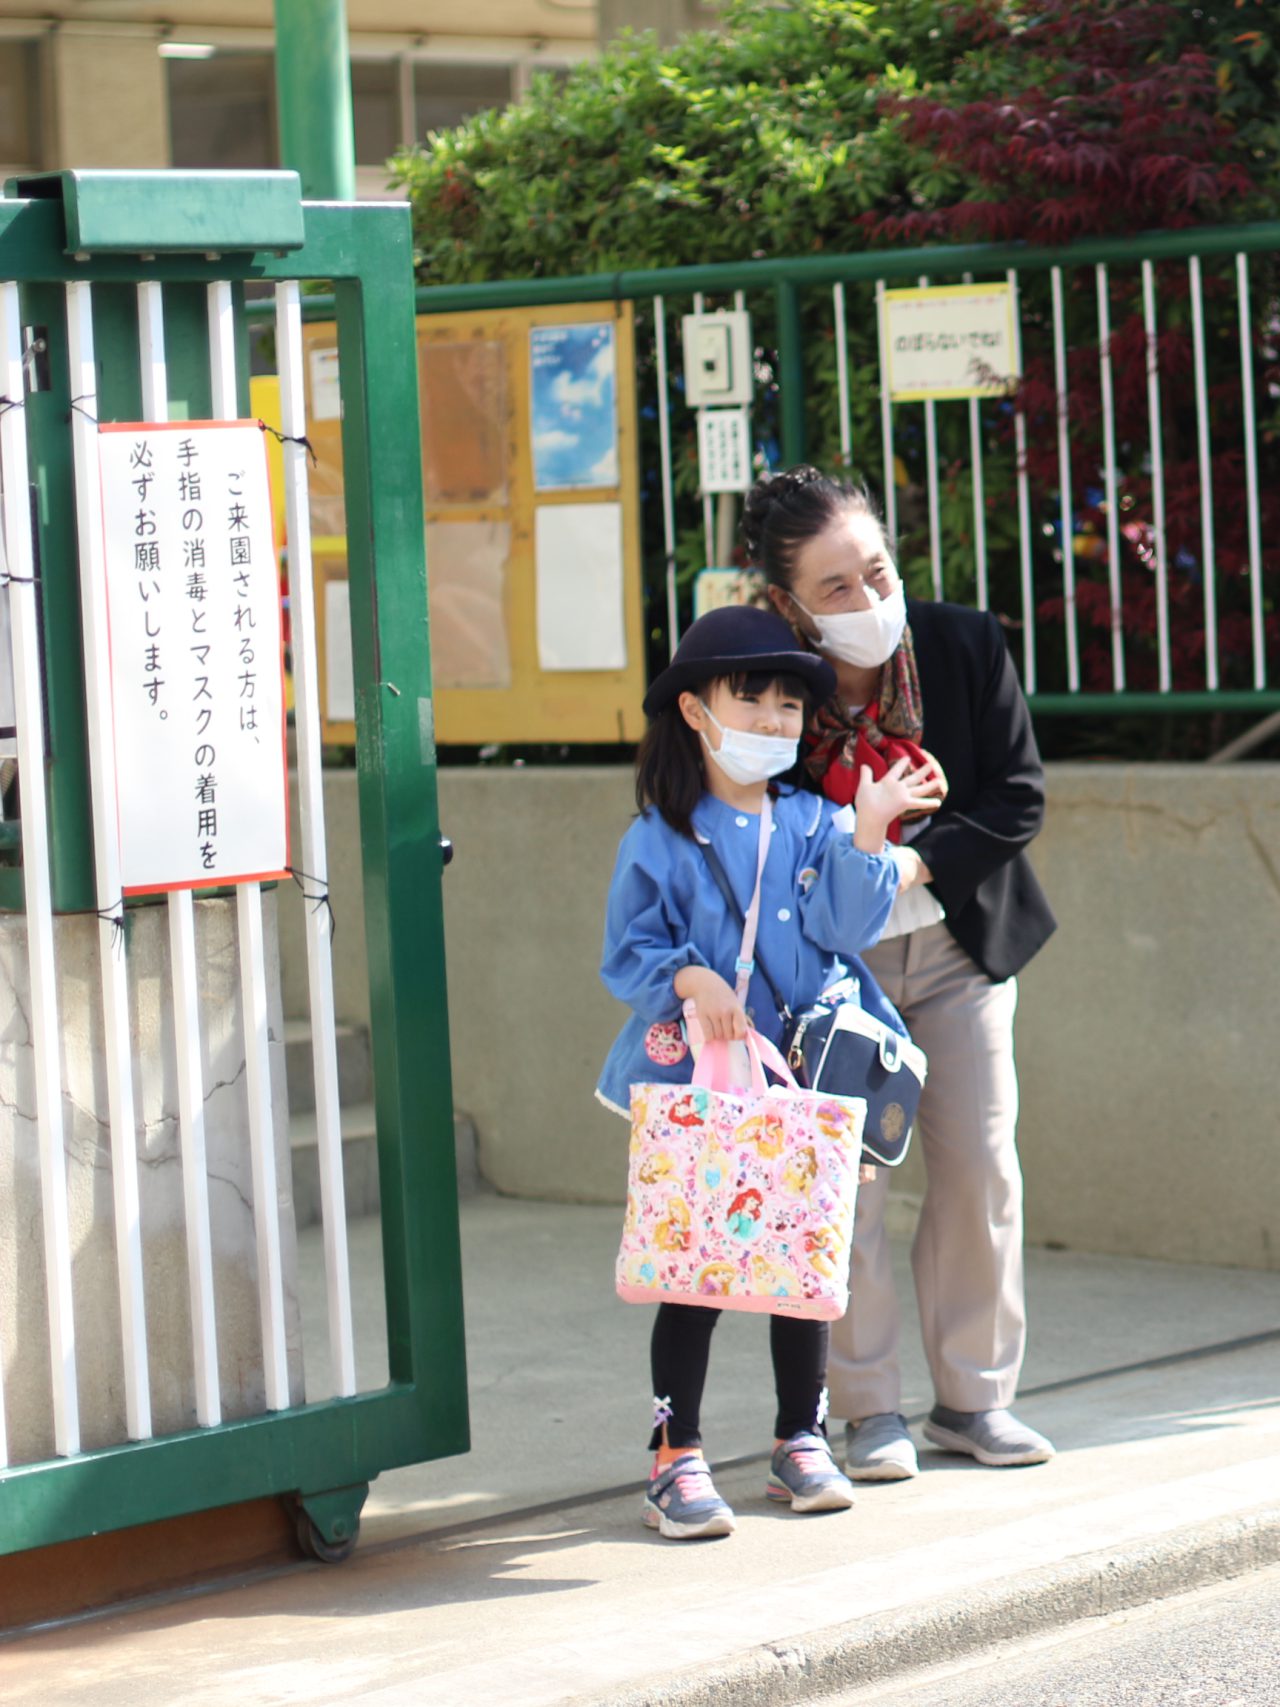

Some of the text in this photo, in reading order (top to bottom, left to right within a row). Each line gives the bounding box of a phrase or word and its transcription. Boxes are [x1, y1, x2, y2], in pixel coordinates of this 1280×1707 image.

[129, 438, 170, 724] 必ずお願いします。
[177, 437, 218, 871] 手指の消毒とマスクの着用を
[226, 470, 262, 746] ご来園される方は、
